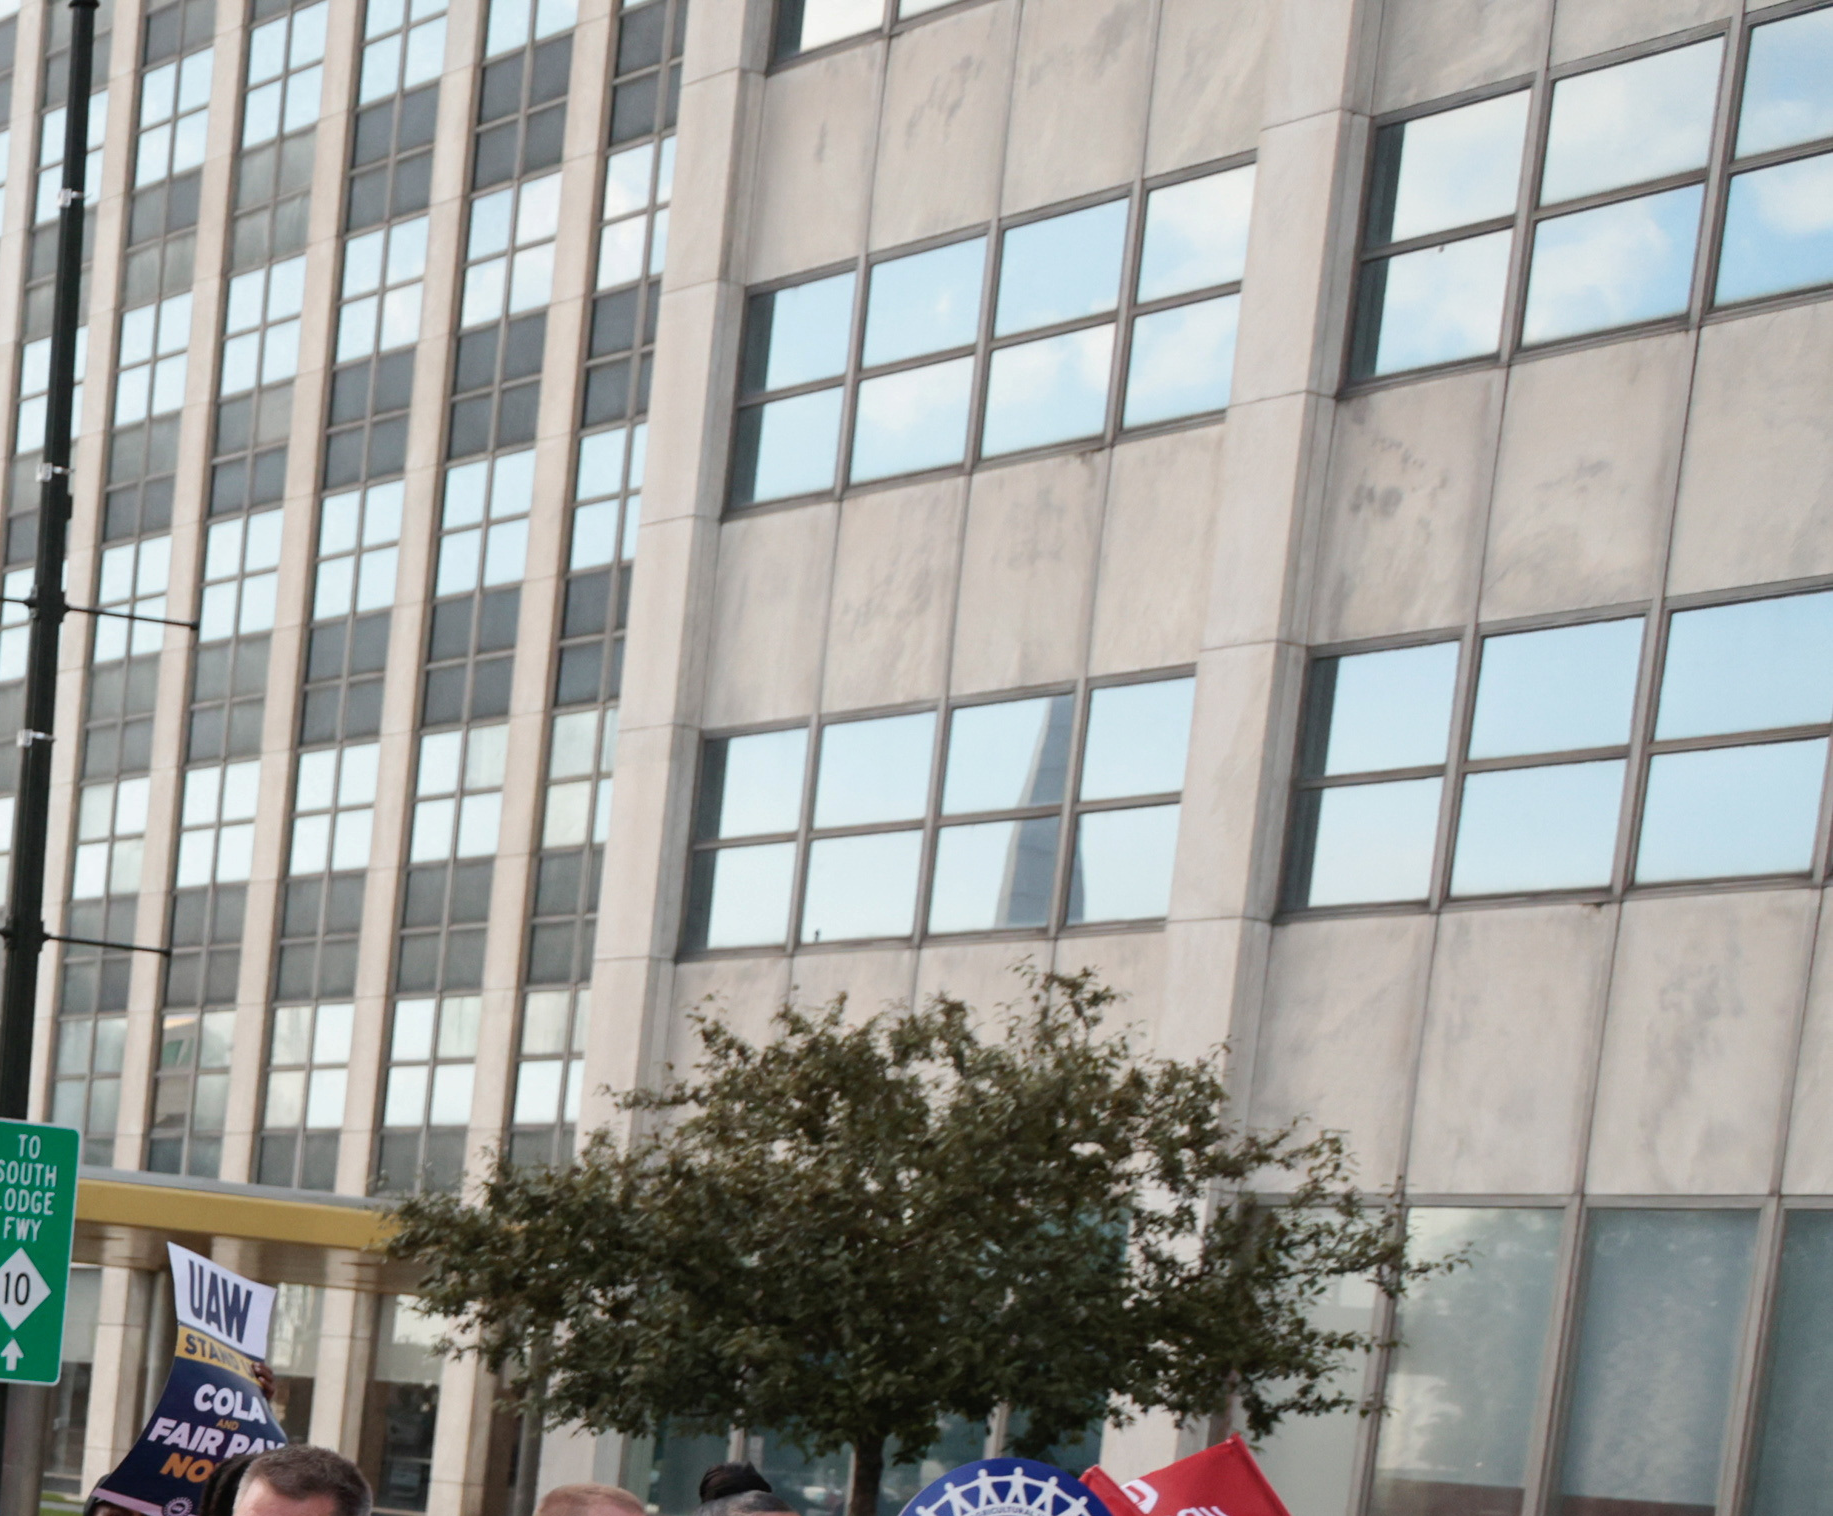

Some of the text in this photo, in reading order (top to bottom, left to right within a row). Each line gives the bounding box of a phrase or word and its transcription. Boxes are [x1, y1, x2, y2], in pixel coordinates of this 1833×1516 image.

[18, 1134, 41, 1159] TO
[3, 1216, 43, 1242] FWY
[4, 1271, 30, 1305] 10
[188, 1258, 253, 1344] UAW
[185, 1334, 241, 1374] STAND
[193, 1383, 268, 1425] COLA
[147, 1416, 225, 1455] FAIR
[216, 1418, 240, 1431] AND
[159, 1452, 216, 1483] NO
